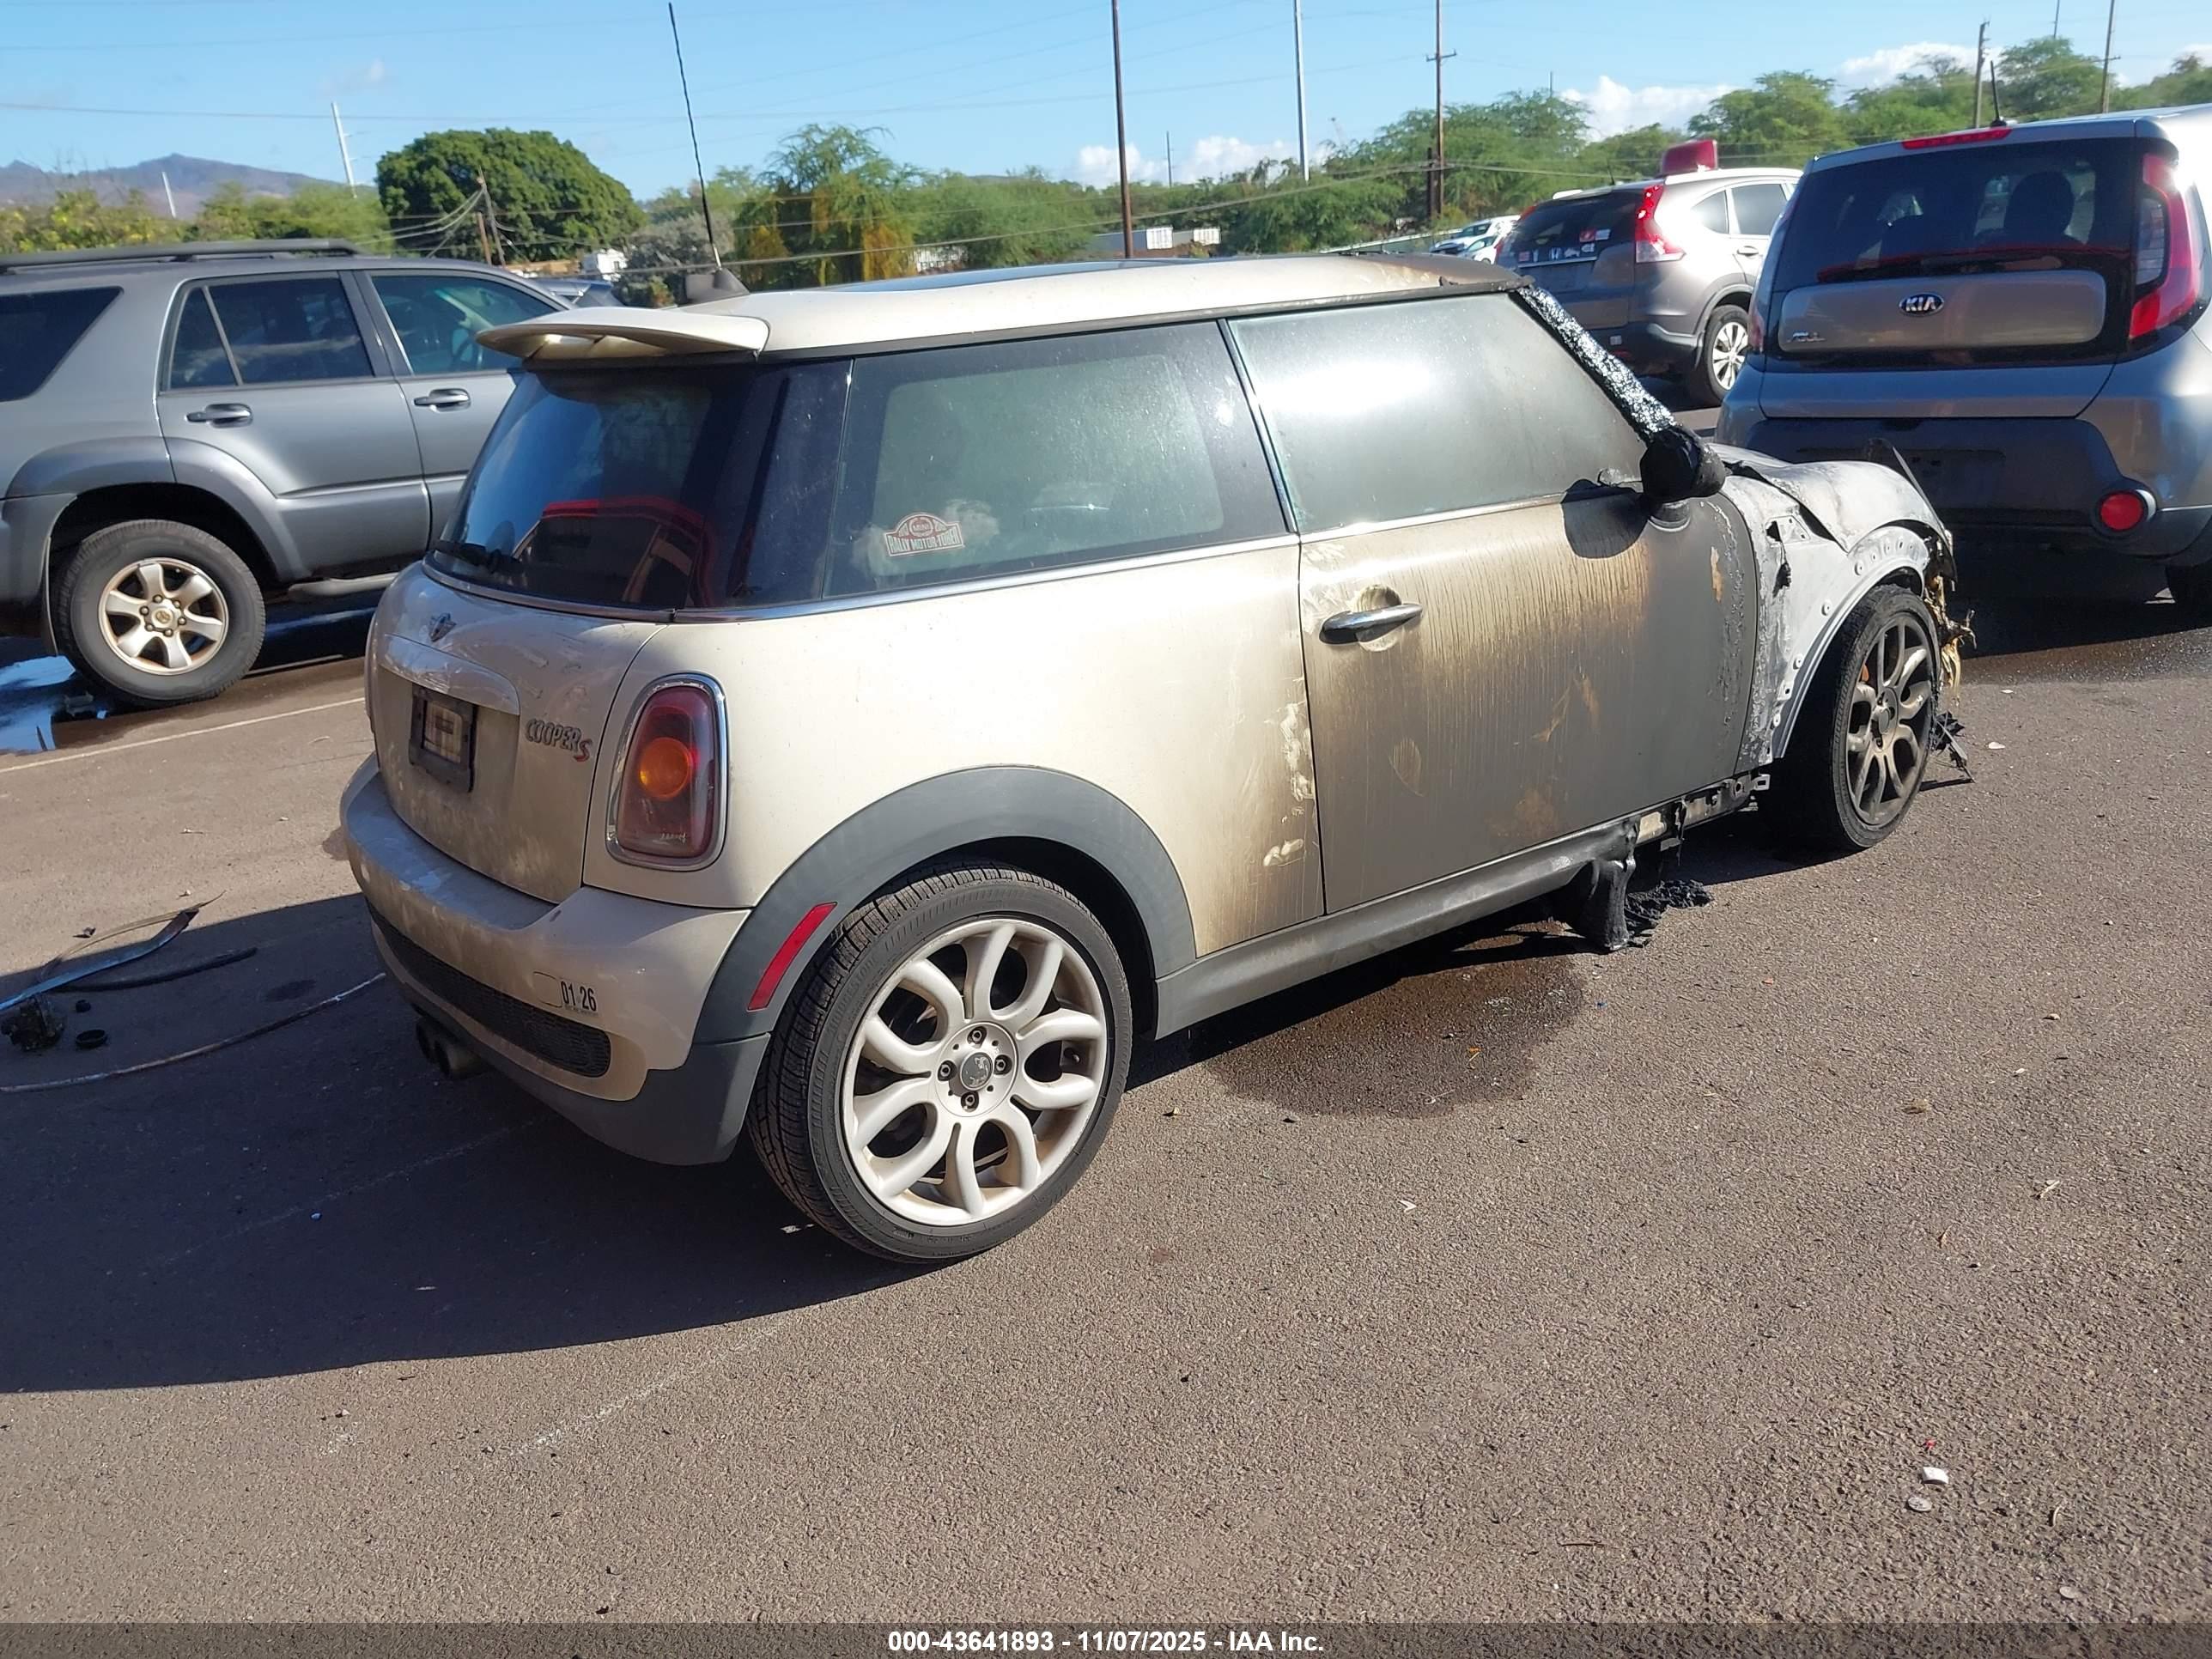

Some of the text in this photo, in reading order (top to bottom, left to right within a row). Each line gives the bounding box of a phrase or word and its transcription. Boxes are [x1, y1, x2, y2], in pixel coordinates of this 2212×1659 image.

[1905, 296, 1936, 312] KIA
[526, 719, 593, 763] COOPER S
[560, 981, 576, 1006] 01
[580, 986, 597, 1012] 26
